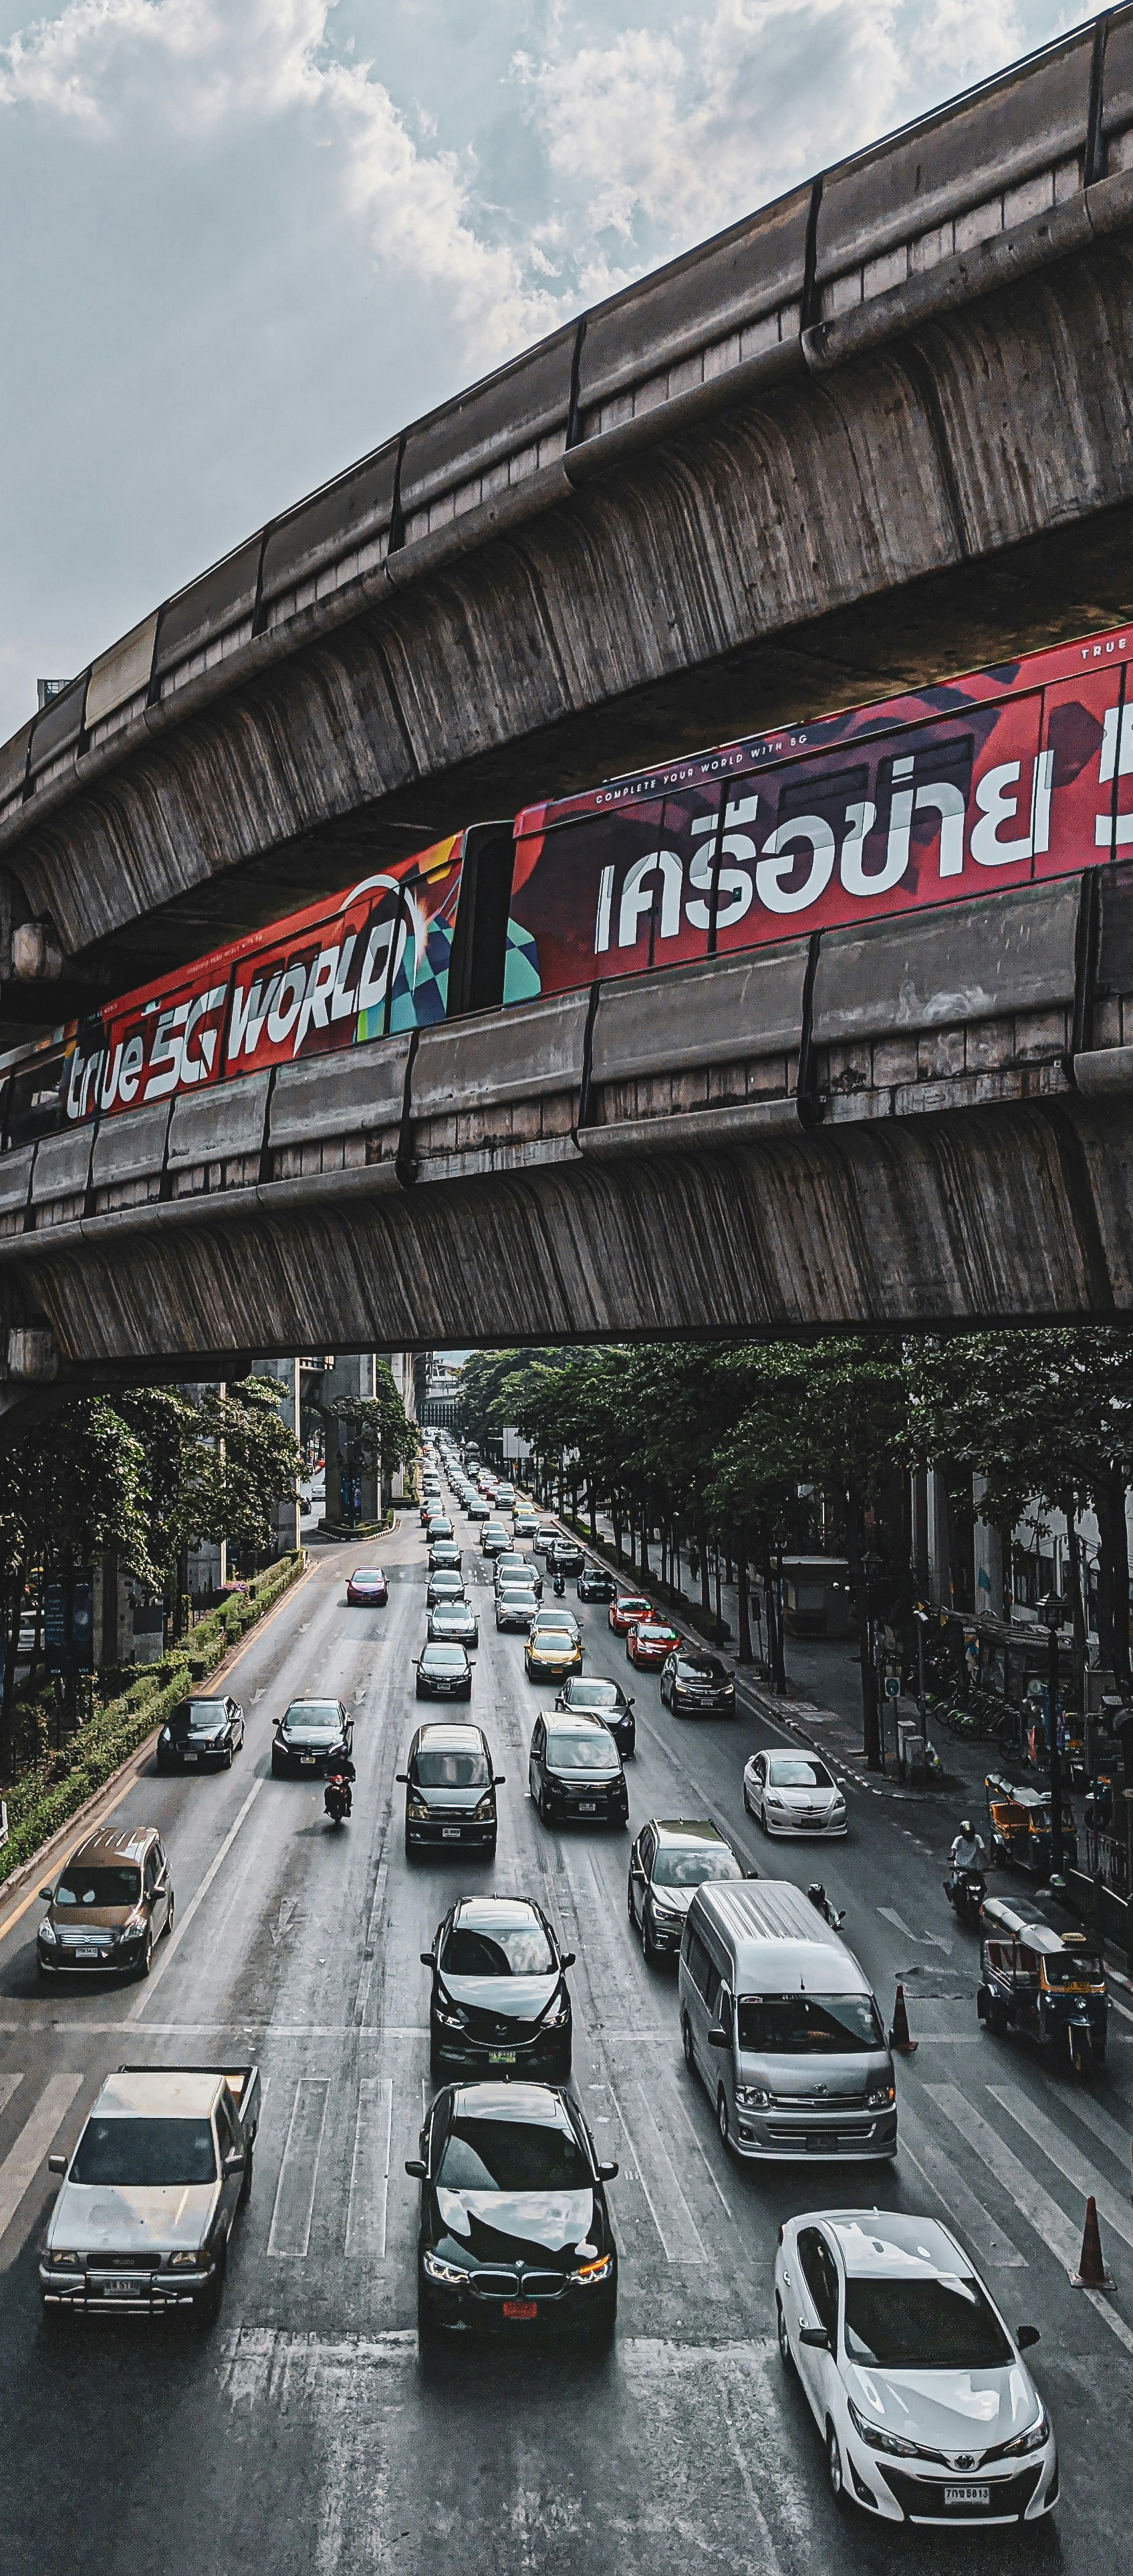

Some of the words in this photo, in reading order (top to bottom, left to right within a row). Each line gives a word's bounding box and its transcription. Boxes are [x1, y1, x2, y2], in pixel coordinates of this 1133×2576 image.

[1082, 638, 1126, 659] TRUE
[596, 779, 656, 804] COMPLETE
[664, 768, 694, 784] YOUR
[701, 753, 743, 772] WORLD
[751, 742, 782, 758] WITH
[790, 734, 807, 746] 5G
[594, 749, 1055, 955] เครือข่าย
[67, 1036, 144, 1119] true
[143, 983, 227, 1101] 5G
[228, 918, 407, 1060] WORLD
